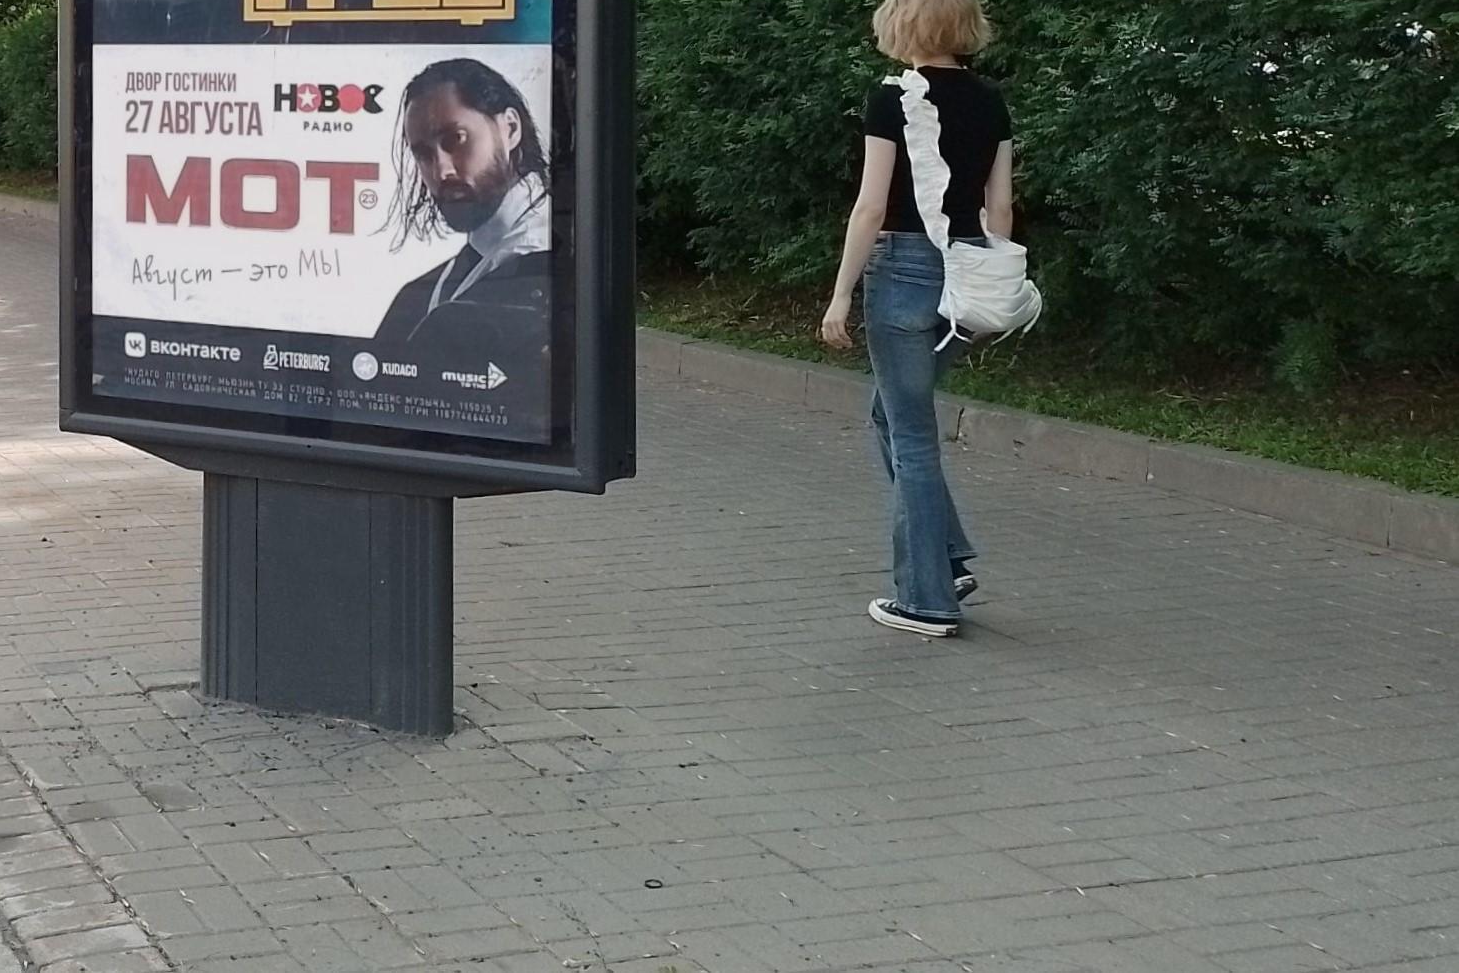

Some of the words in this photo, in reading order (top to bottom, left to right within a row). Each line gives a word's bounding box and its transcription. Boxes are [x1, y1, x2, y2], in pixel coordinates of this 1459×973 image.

[125, 72, 163, 95] ДВОР
[165, 72, 237, 93] ГОСТИНКИ
[125, 100, 154, 134] 27
[158, 100, 264, 137] АВГУСТА
[303, 120, 354, 133] РАДИО
[125, 153, 381, 236] МОТ
[131, 256, 213, 299] Август
[249, 264, 289, 283] это
[298, 248, 342, 278] МЫ
[150, 339, 242, 362] вконтакте
